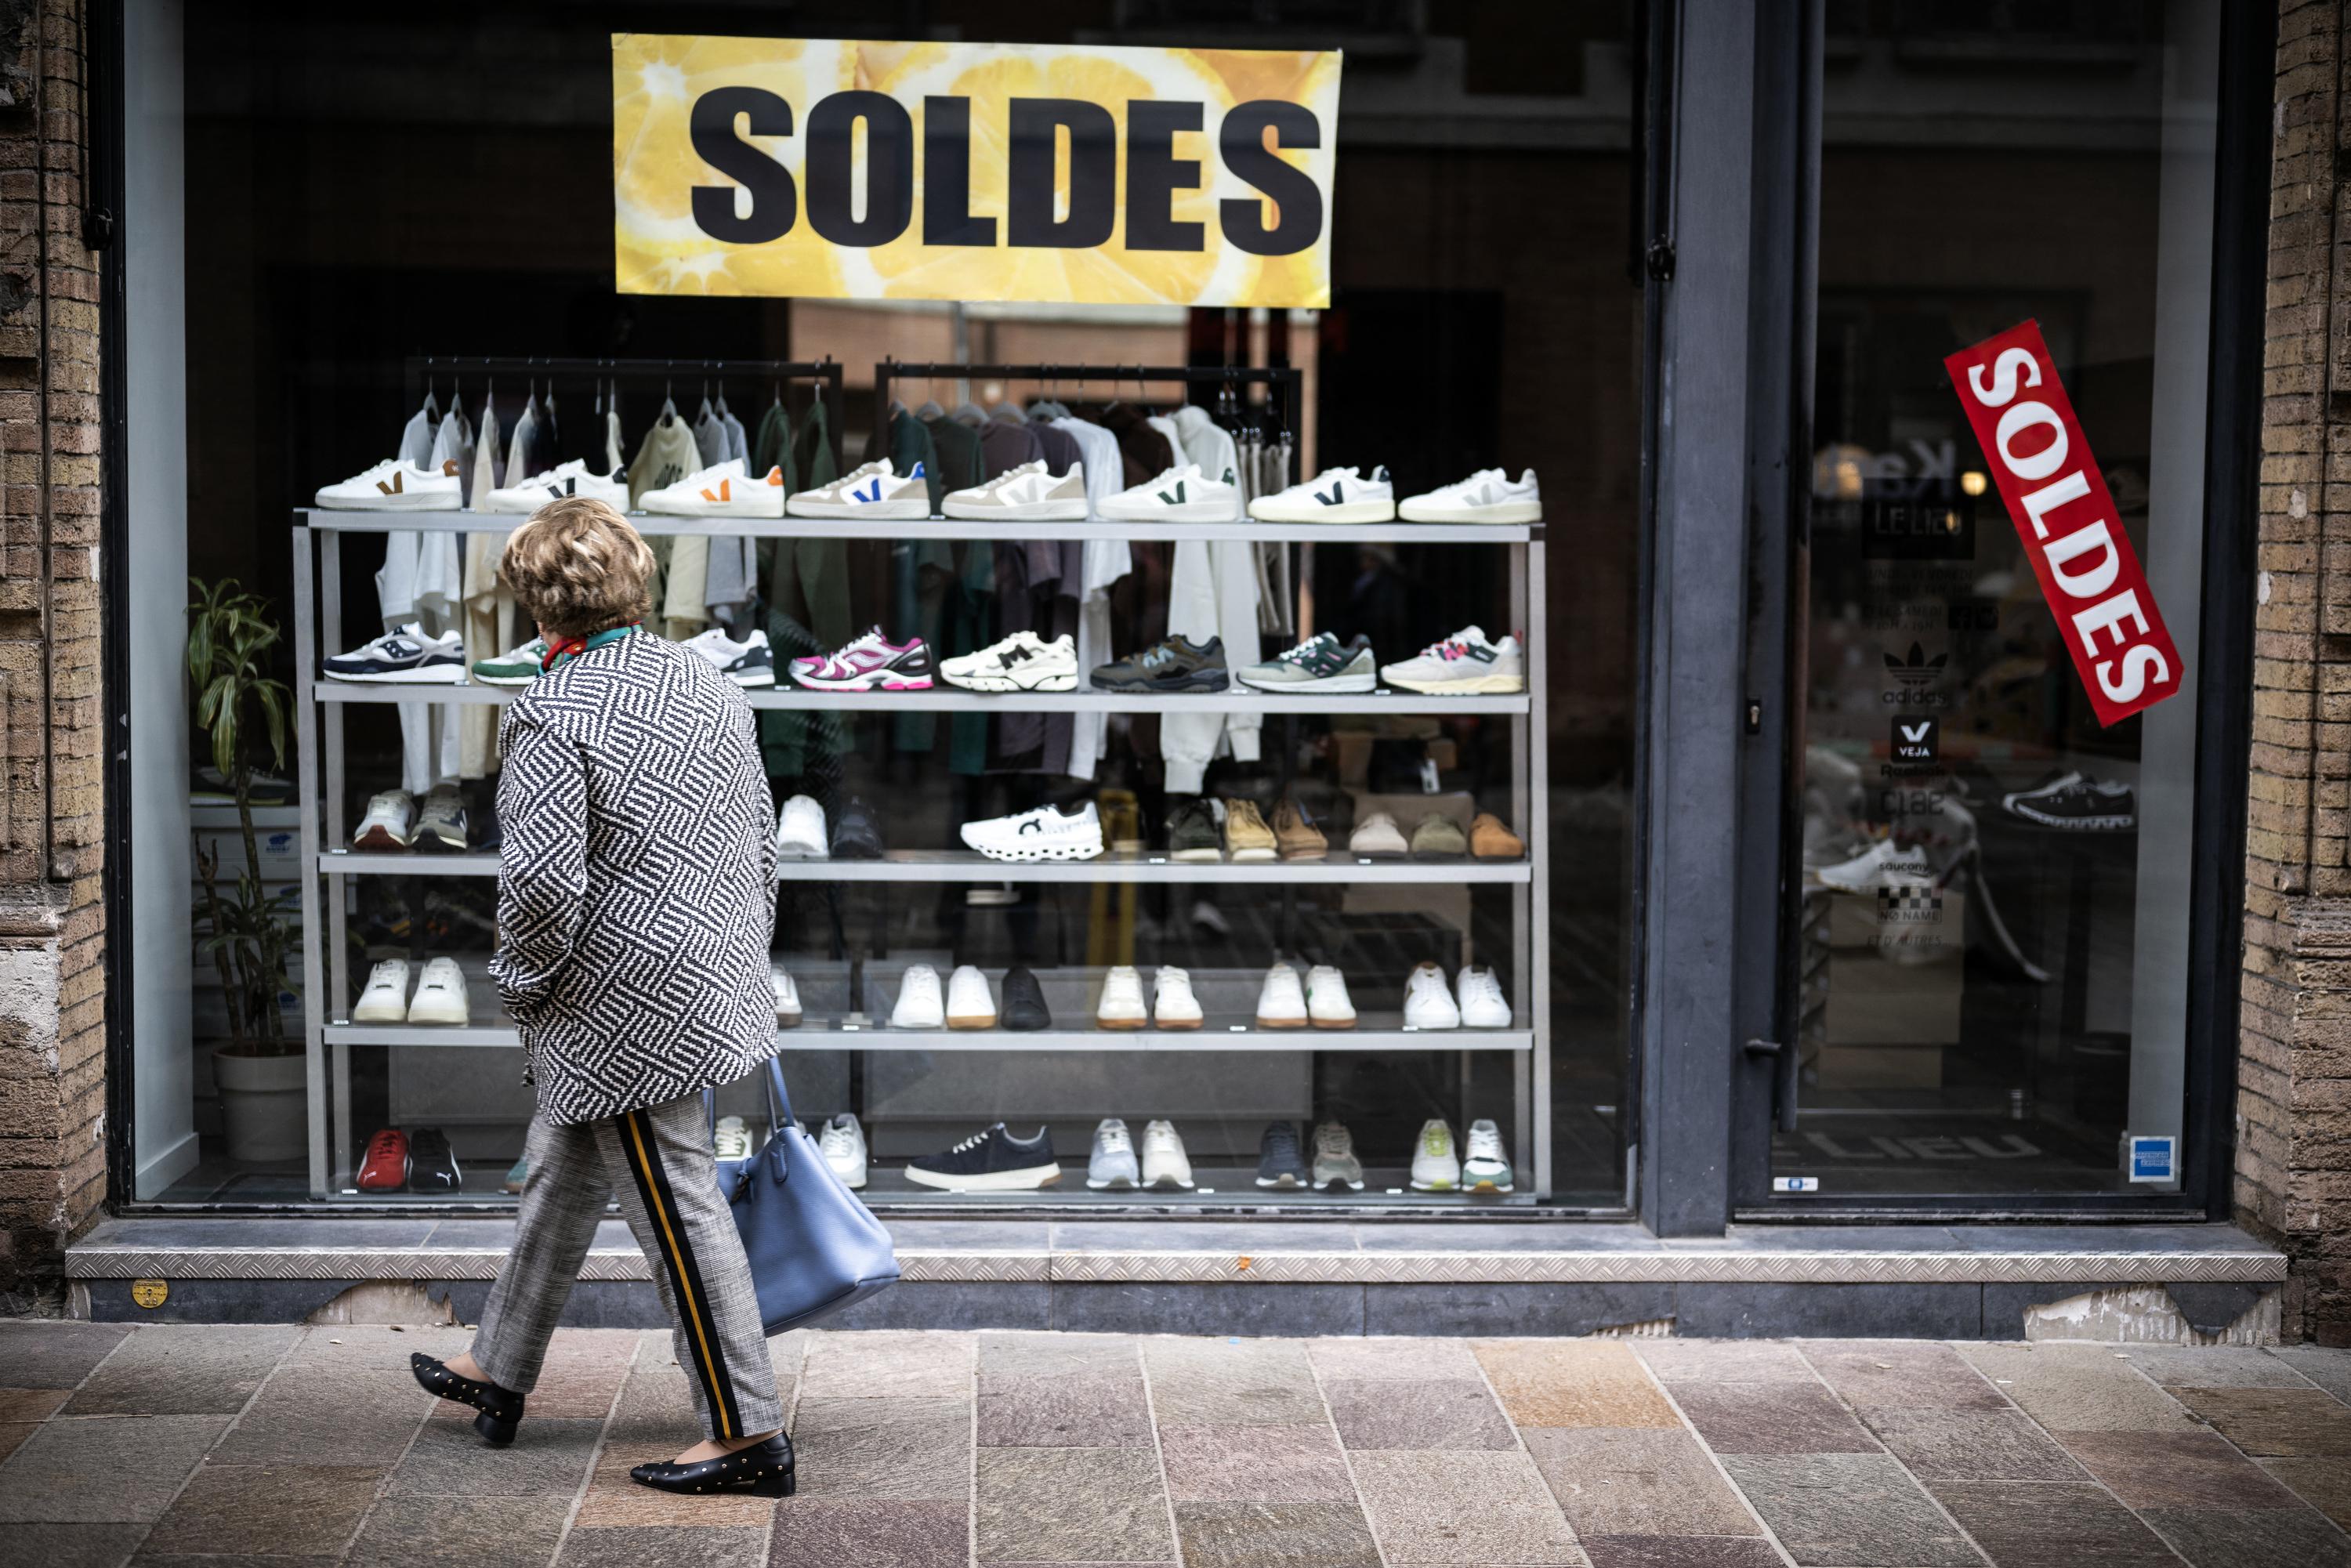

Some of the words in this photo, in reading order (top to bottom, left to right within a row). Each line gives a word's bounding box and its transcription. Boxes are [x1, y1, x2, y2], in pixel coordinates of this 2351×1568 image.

[690, 85, 1323, 256] SOLDES
[1967, 347, 2169, 704] SOLDES
[1882, 689, 1947, 704] adidas
[1899, 747, 1930, 757] VEJA
[1879, 862, 1929, 873] saucony
[1903, 911, 1939, 921] NAME
[1804, 1132, 2041, 1159] LIEU
